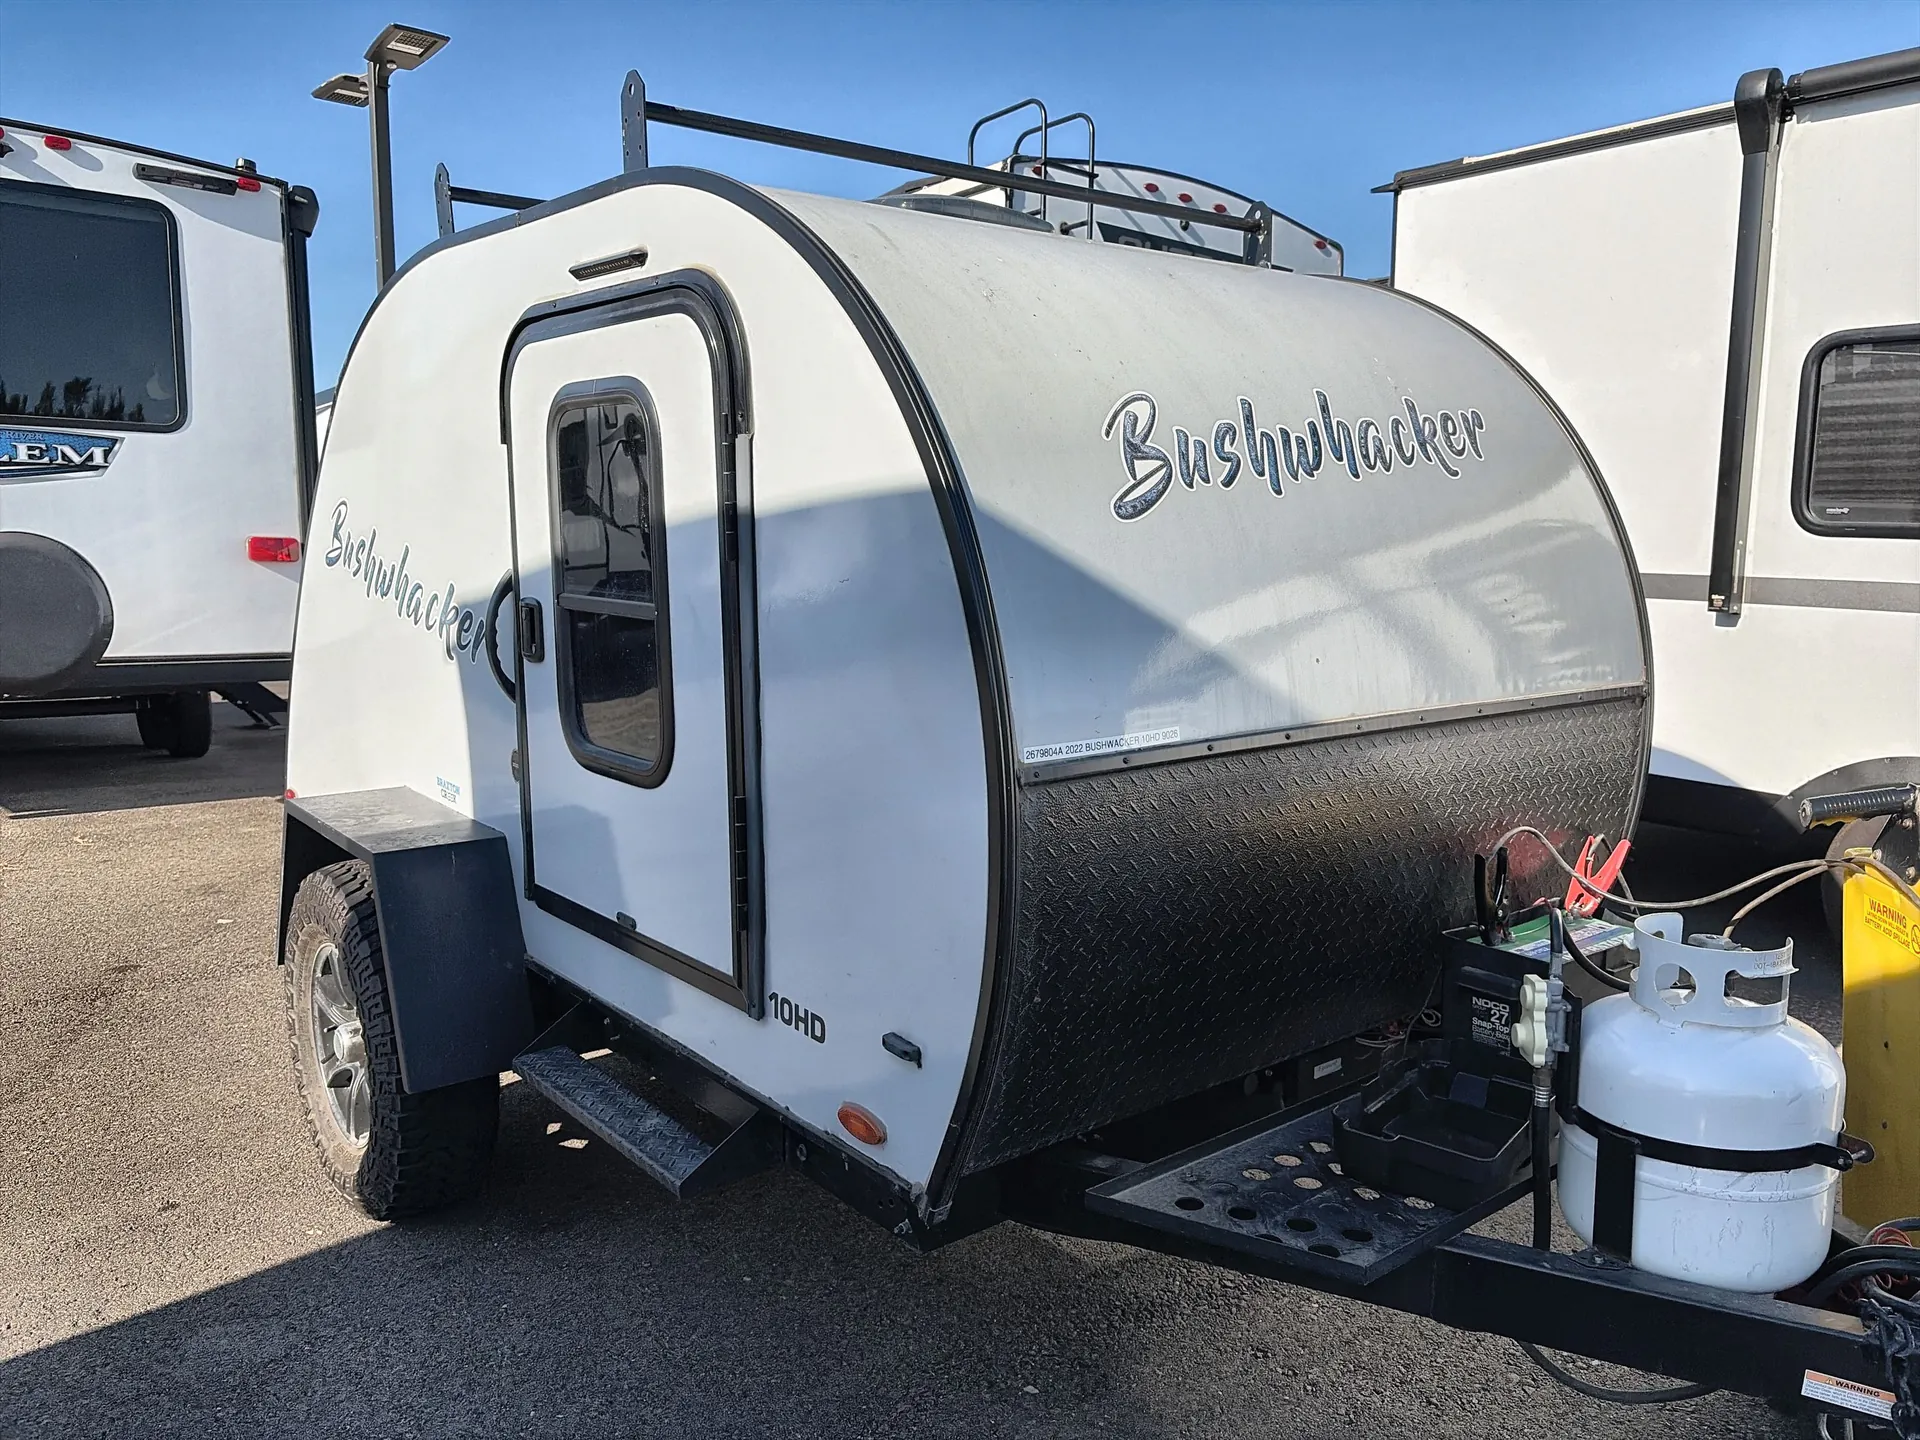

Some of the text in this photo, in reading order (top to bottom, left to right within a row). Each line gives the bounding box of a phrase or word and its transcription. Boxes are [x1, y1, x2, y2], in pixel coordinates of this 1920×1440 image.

[6, 431, 45, 440] RIVER
[1102, 388, 1485, 521] Bushwhacker
[325, 499, 487, 663] Bushwhacker
[1025, 729, 1179, 760] 2679804A 2022 BUSHWACKER 10HD 9026
[1869, 898, 1907, 929] WARNING
[1865, 916, 1911, 949] BATTERY ACID SPILLAGE
[768, 991, 826, 1044] 10HD
[1472, 996, 1509, 1012] NOCO
[1490, 1009, 1509, 1025] 27
[1472, 1016, 1509, 1034] Snap-Top
[1835, 1380, 1881, 1397] WARNING
